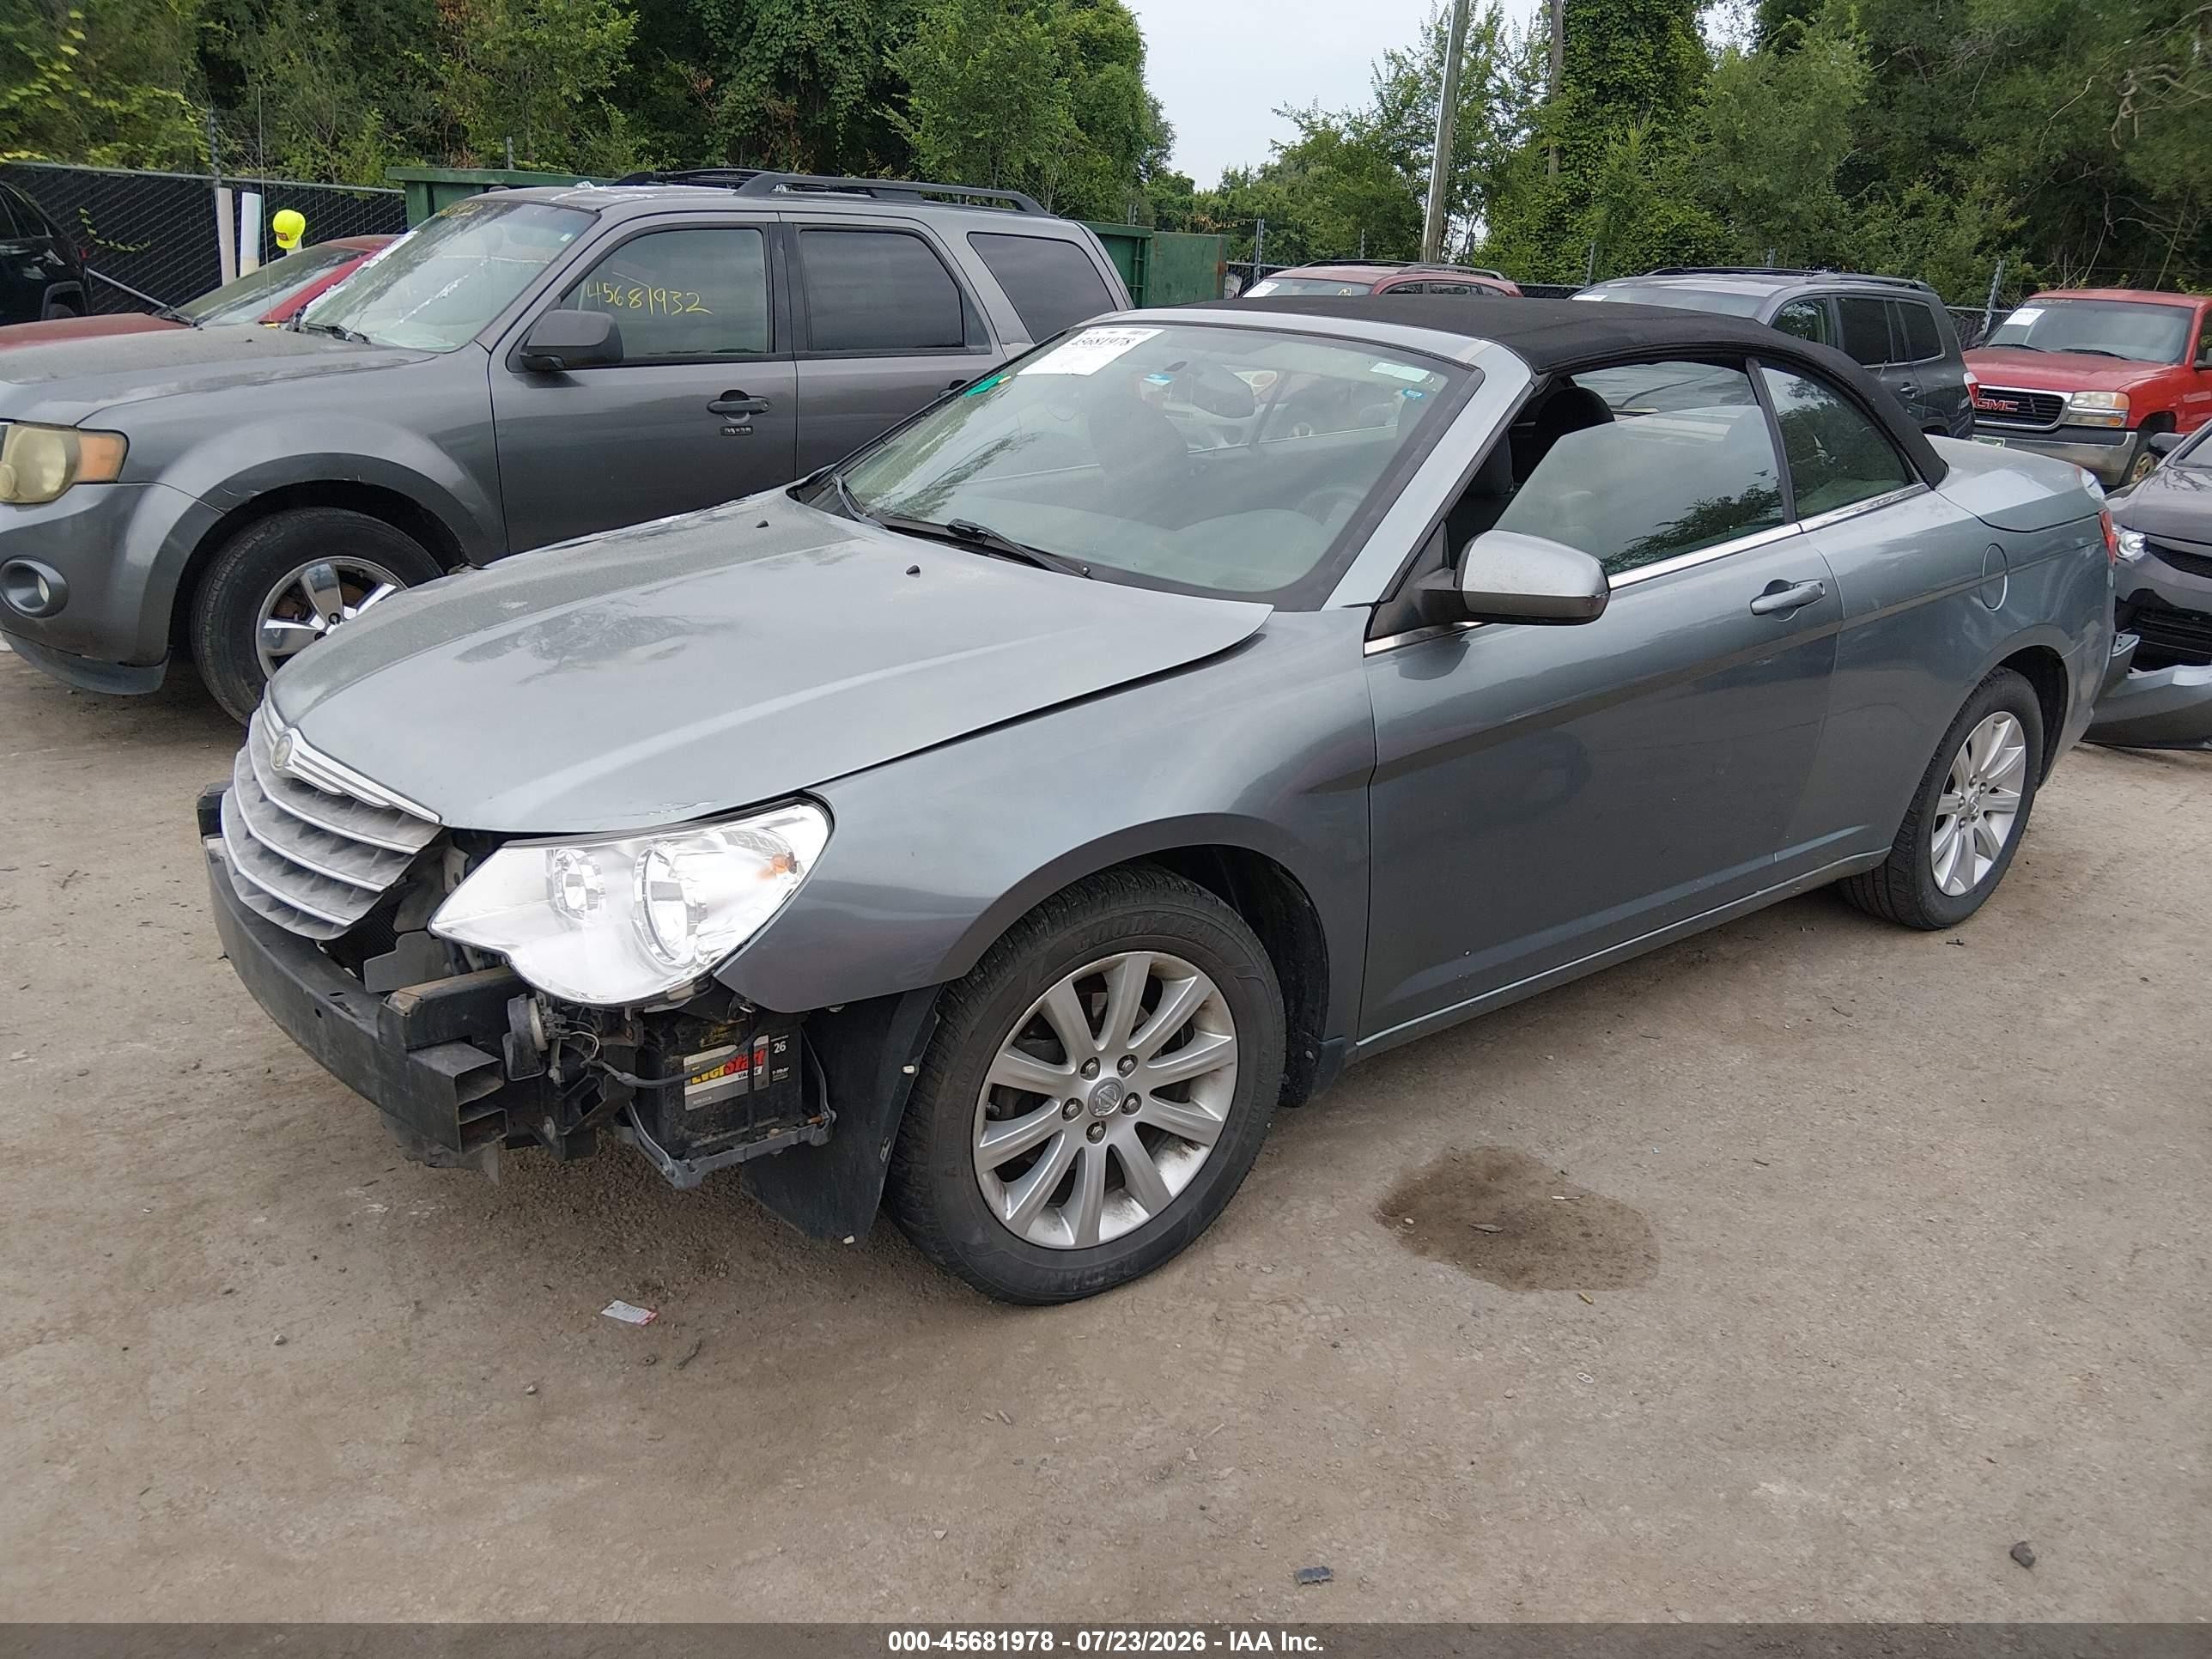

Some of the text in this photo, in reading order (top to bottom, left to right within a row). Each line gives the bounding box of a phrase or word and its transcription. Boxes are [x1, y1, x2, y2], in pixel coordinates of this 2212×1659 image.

[587, 281, 714, 316] 45681932
[1976, 398, 2020, 412] GMC
[774, 1041, 787, 1054] 26
[738, 1066, 761, 1079] VAE
